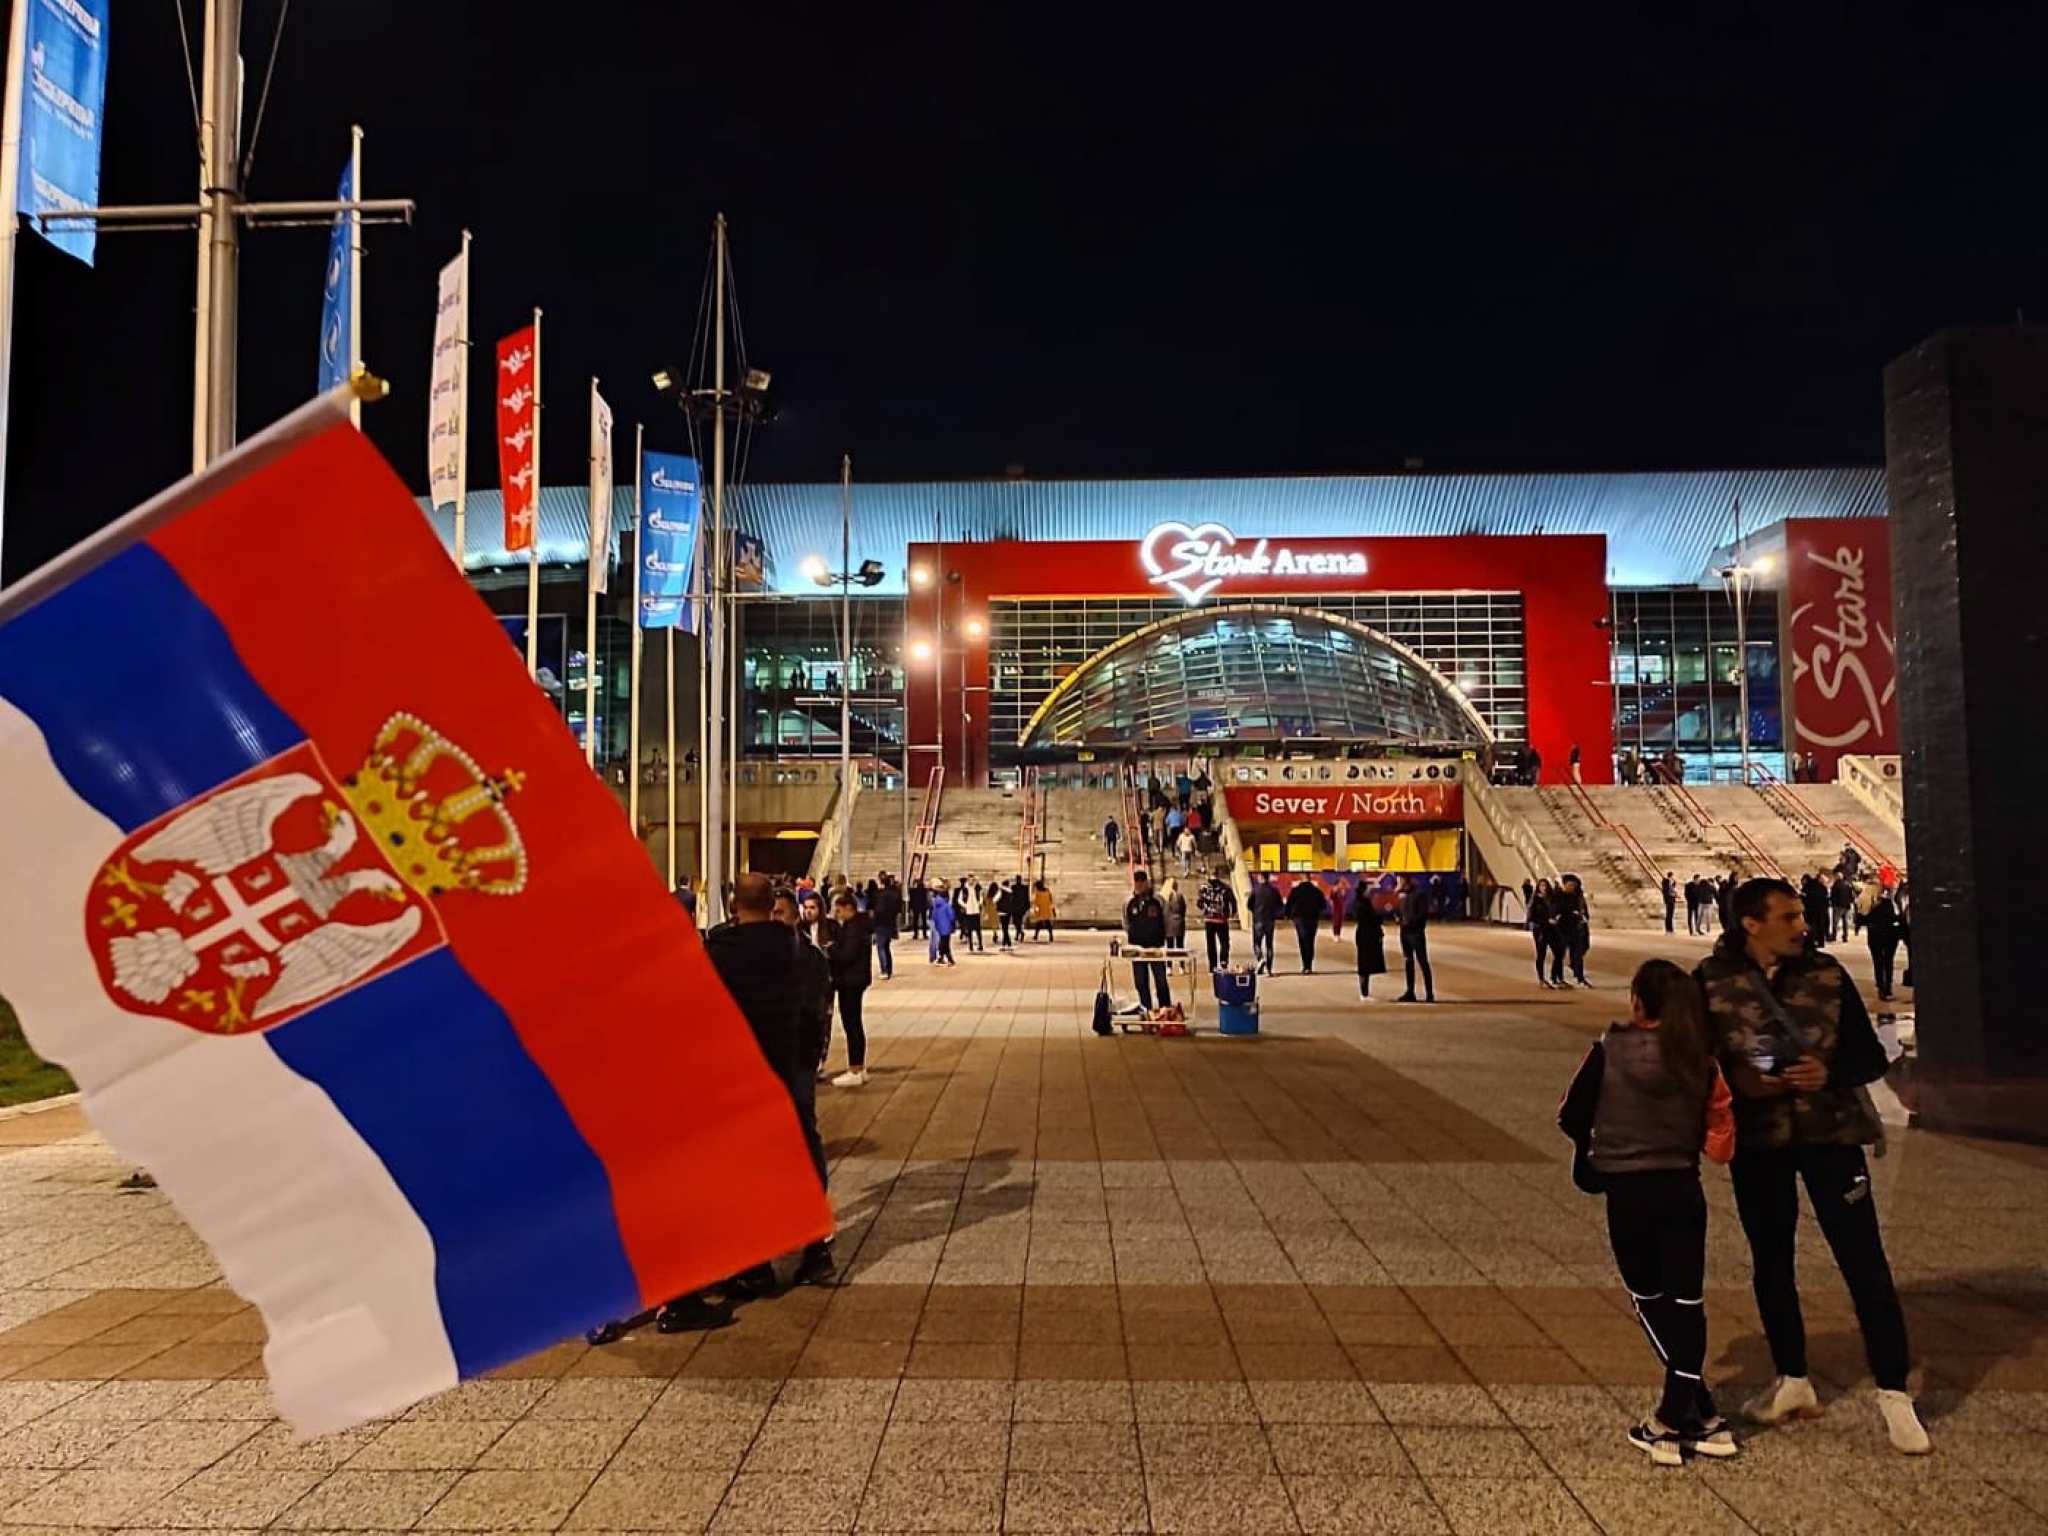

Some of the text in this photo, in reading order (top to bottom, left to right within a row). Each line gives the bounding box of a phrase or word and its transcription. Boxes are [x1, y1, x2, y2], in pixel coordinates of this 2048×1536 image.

[1273, 548, 1369, 576] Arena
[1256, 791, 1426, 815] Sever / North
